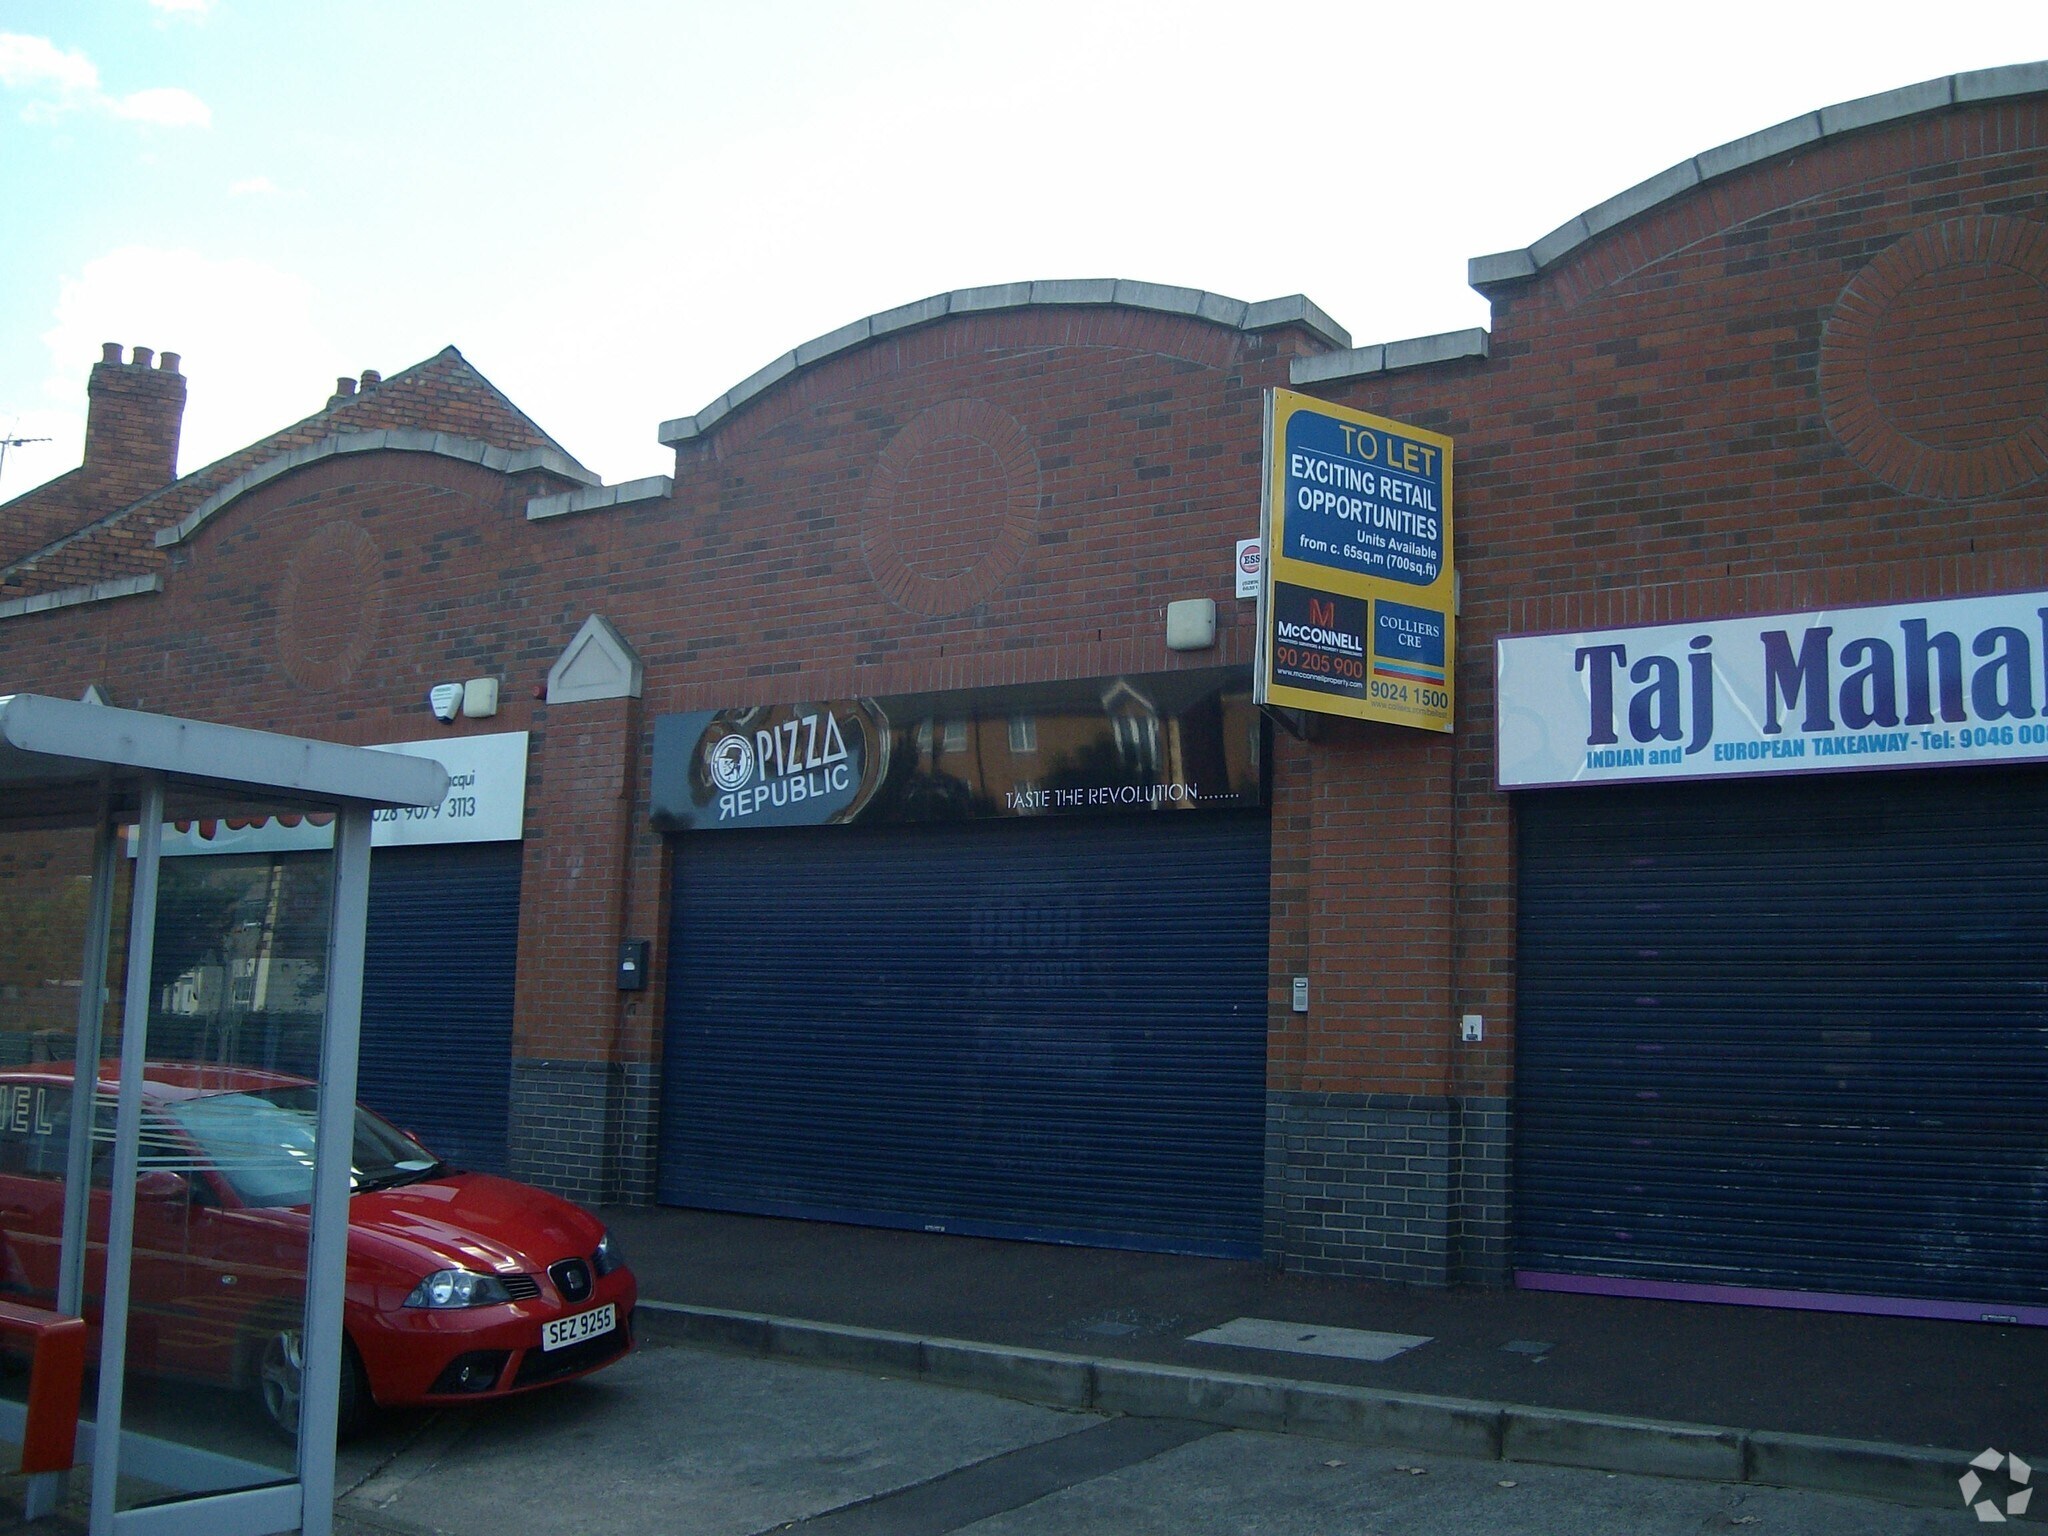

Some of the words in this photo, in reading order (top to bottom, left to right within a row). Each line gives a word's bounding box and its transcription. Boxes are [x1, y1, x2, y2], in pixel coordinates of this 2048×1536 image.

[1339, 424, 1378, 460] TO
[1386, 438, 1436, 477] LET
[1291, 453, 1375, 495] EXCITING
[1380, 475, 1437, 512] RETAIL
[1298, 486, 1437, 541] OPPORTUNITIES
[1300, 534, 1327, 552] from
[1330, 544, 1340, 555] c.
[1343, 544, 1384, 564] 65sq.m
[1386, 554, 1437, 579] (700sq.ft)
[1357, 529, 1386, 548] Units
[1388, 537, 1437, 560] Available
[1278, 620, 1362, 651] McCONNELL
[1380, 615, 1440, 637] COLLIERS
[1398, 633, 1422, 648] CRE
[1277, 646, 1298, 667] 90
[1301, 651, 1330, 673] 205
[1333, 657, 1363, 679] 900
[1371, 680, 1408, 702] 9024
[1413, 687, 1448, 709] 1500
[1575, 634, 1713, 755] Taj
[1760, 607, 2048, 735] Maha
[756, 710, 848, 781] PIZZA
[1587, 749, 1645, 769] INDIAN
[1649, 746, 1682, 765] and
[1714, 738, 1805, 762] EUROPEAN
[1920, 730, 1955, 750] Tel:
[1959, 725, 2013, 749] 9046
[2018, 723, 2048, 745] 00
[448, 796, 476, 818] 3113
[1005, 790, 1050, 809] TASTE
[1055, 787, 1084, 807] THE
[549, 1318, 577, 1344] SEZ
[581, 1307, 611, 1335] 9255
